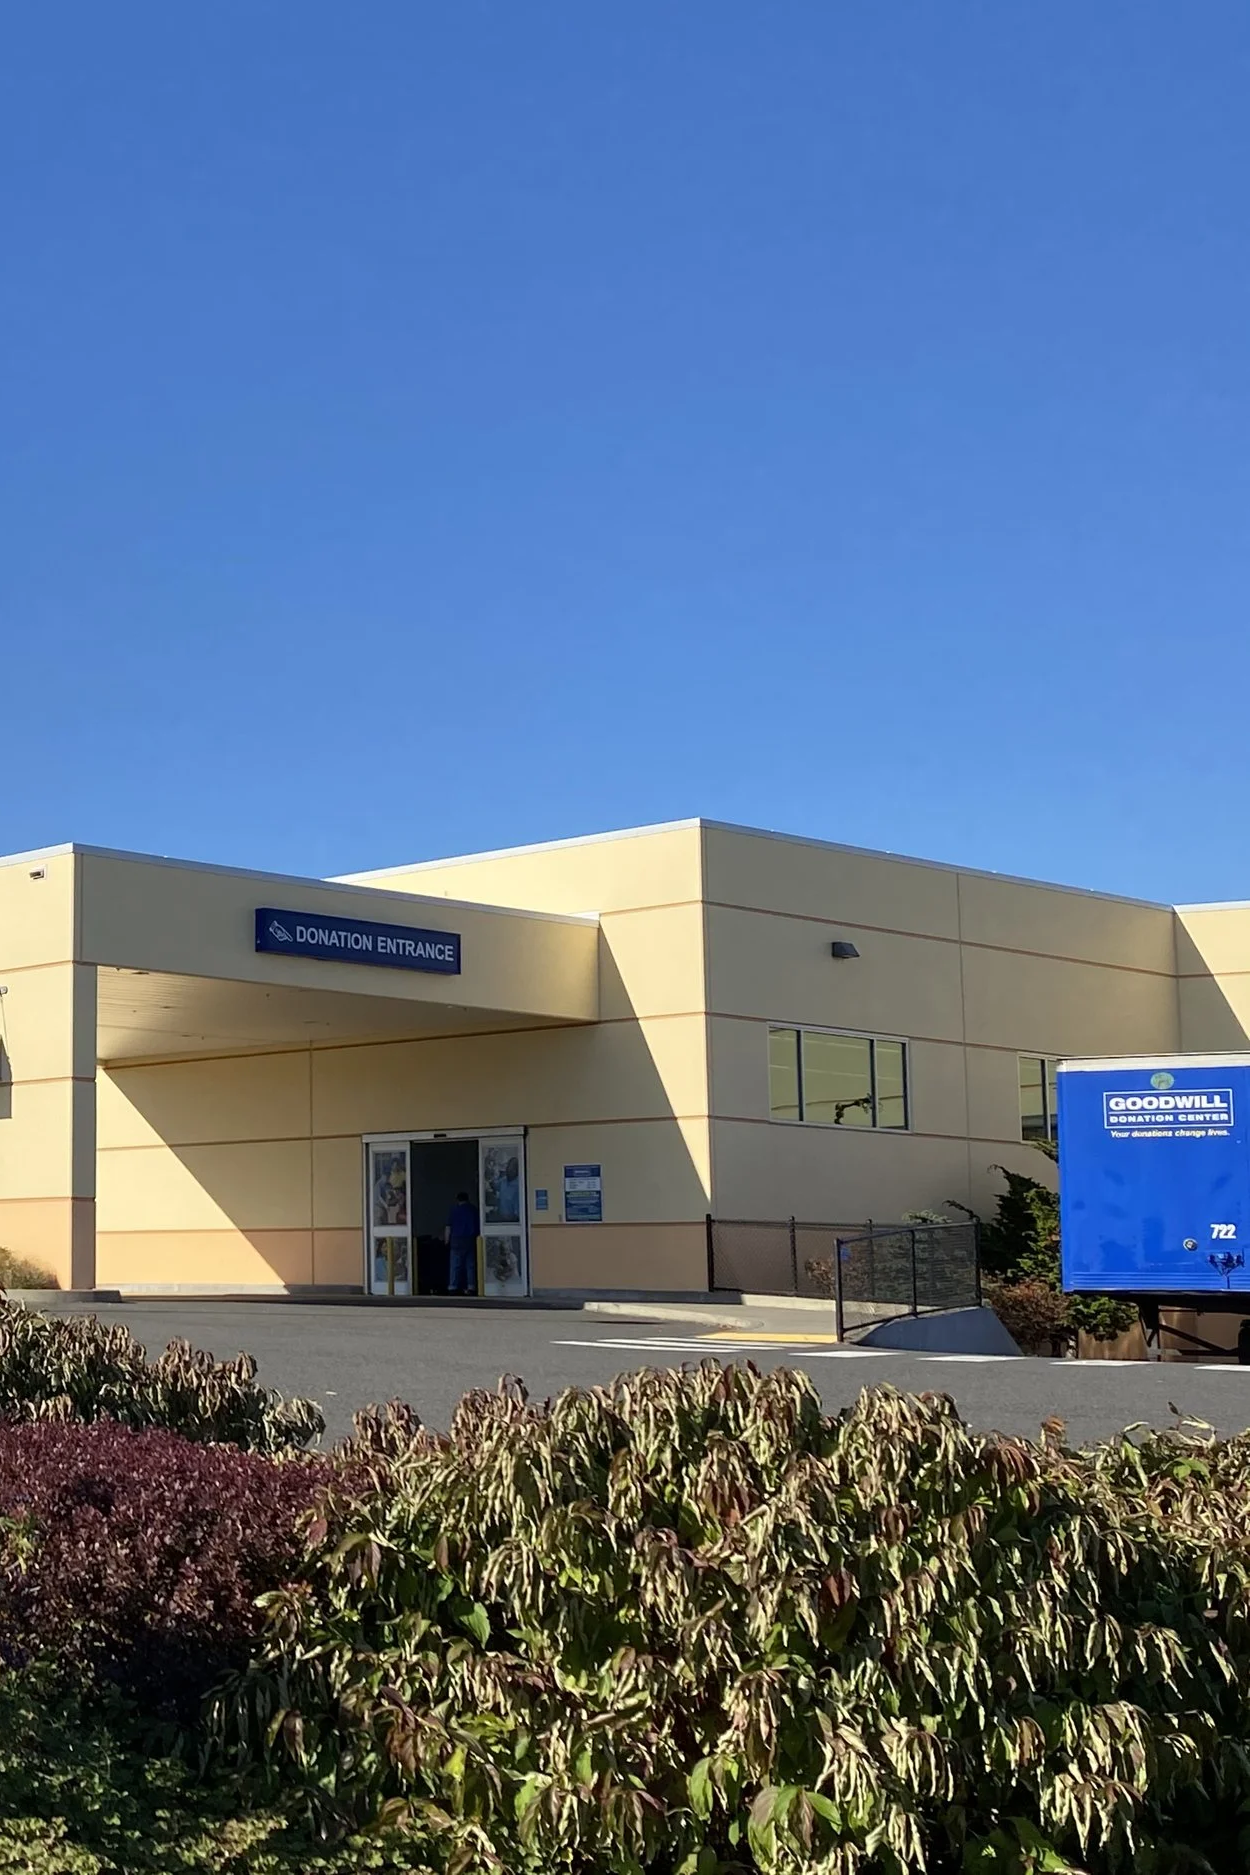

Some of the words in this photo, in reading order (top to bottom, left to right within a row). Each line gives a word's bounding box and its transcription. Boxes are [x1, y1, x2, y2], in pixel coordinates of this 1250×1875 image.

[296, 926, 372, 951] DONATION
[377, 936, 454, 961] ENTRANCE
[1109, 1095, 1228, 1111] GOODWILL
[1109, 1114, 1174, 1123] DONATION
[1178, 1113, 1229, 1122] CENTER
[1110, 1130, 1130, 1138] Your
[1131, 1129, 1173, 1138] donations
[1175, 1129, 1206, 1138] change
[1210, 1223, 1237, 1240] 722
